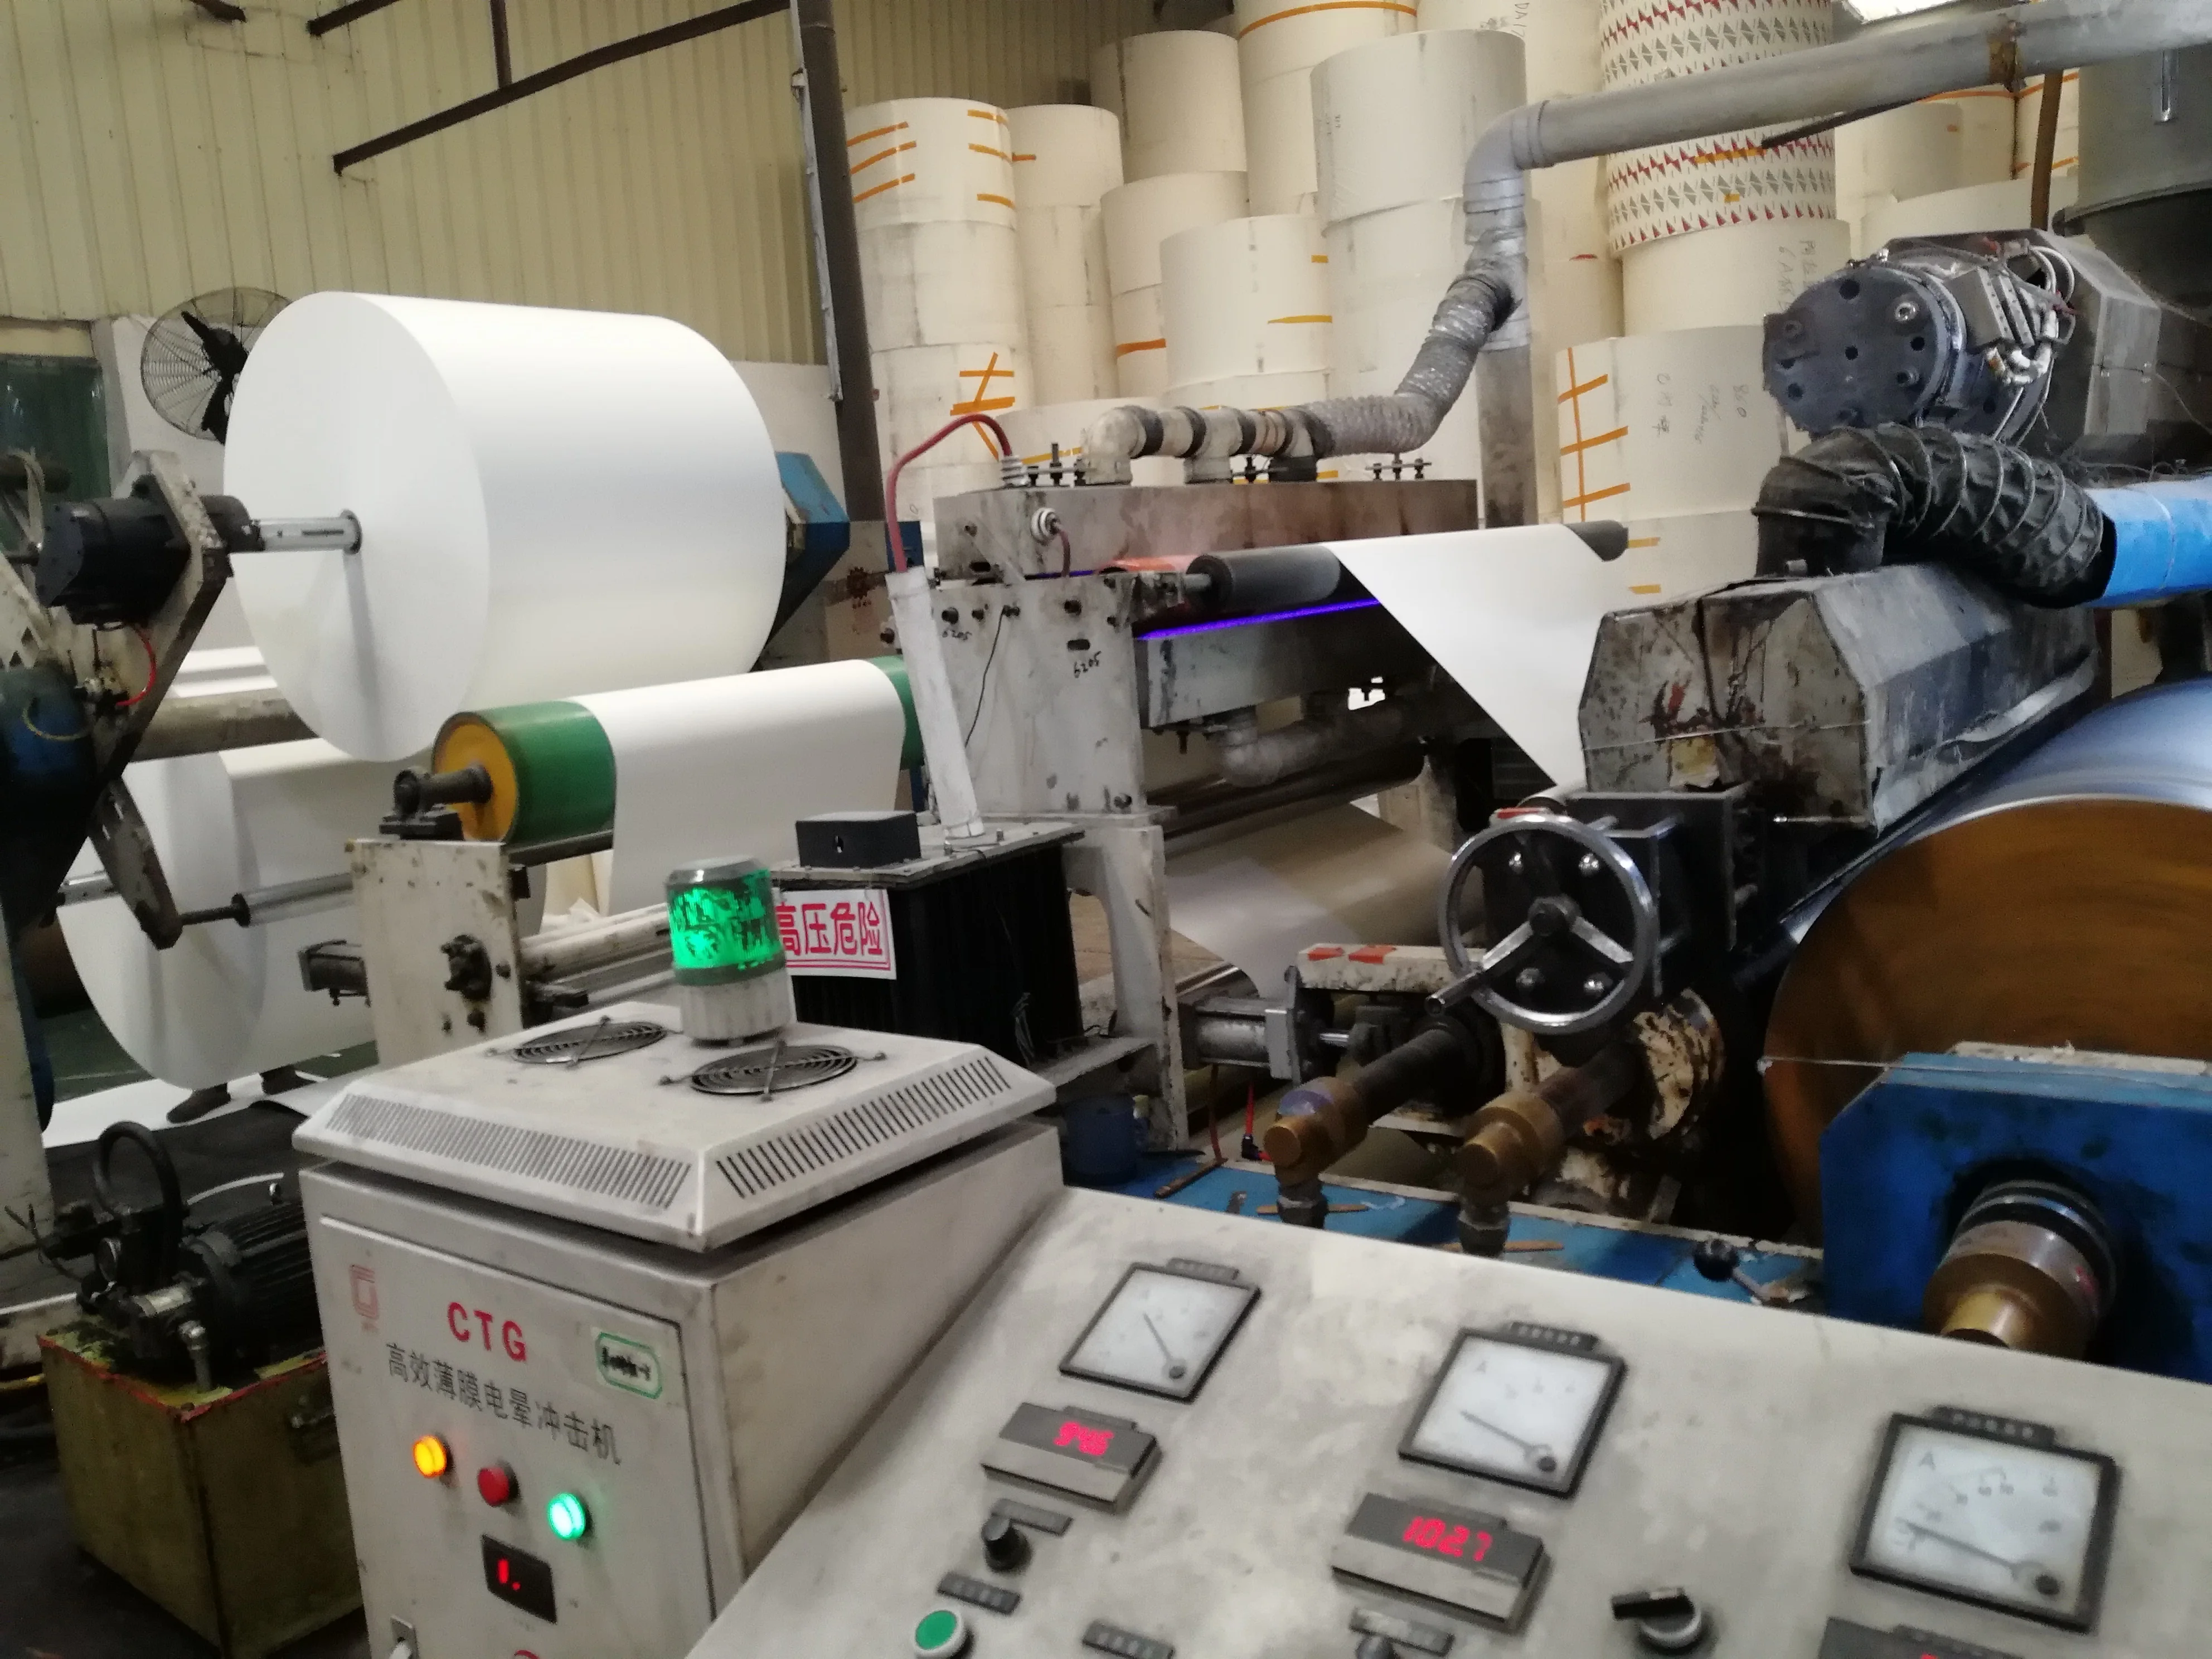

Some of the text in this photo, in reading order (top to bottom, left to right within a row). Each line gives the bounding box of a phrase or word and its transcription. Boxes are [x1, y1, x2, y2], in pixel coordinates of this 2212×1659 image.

[774, 902, 883, 956] 高压危险
[447, 1302, 527, 1361] CTG
[386, 1342, 622, 1466] 高效薄膜电晕冲击机
